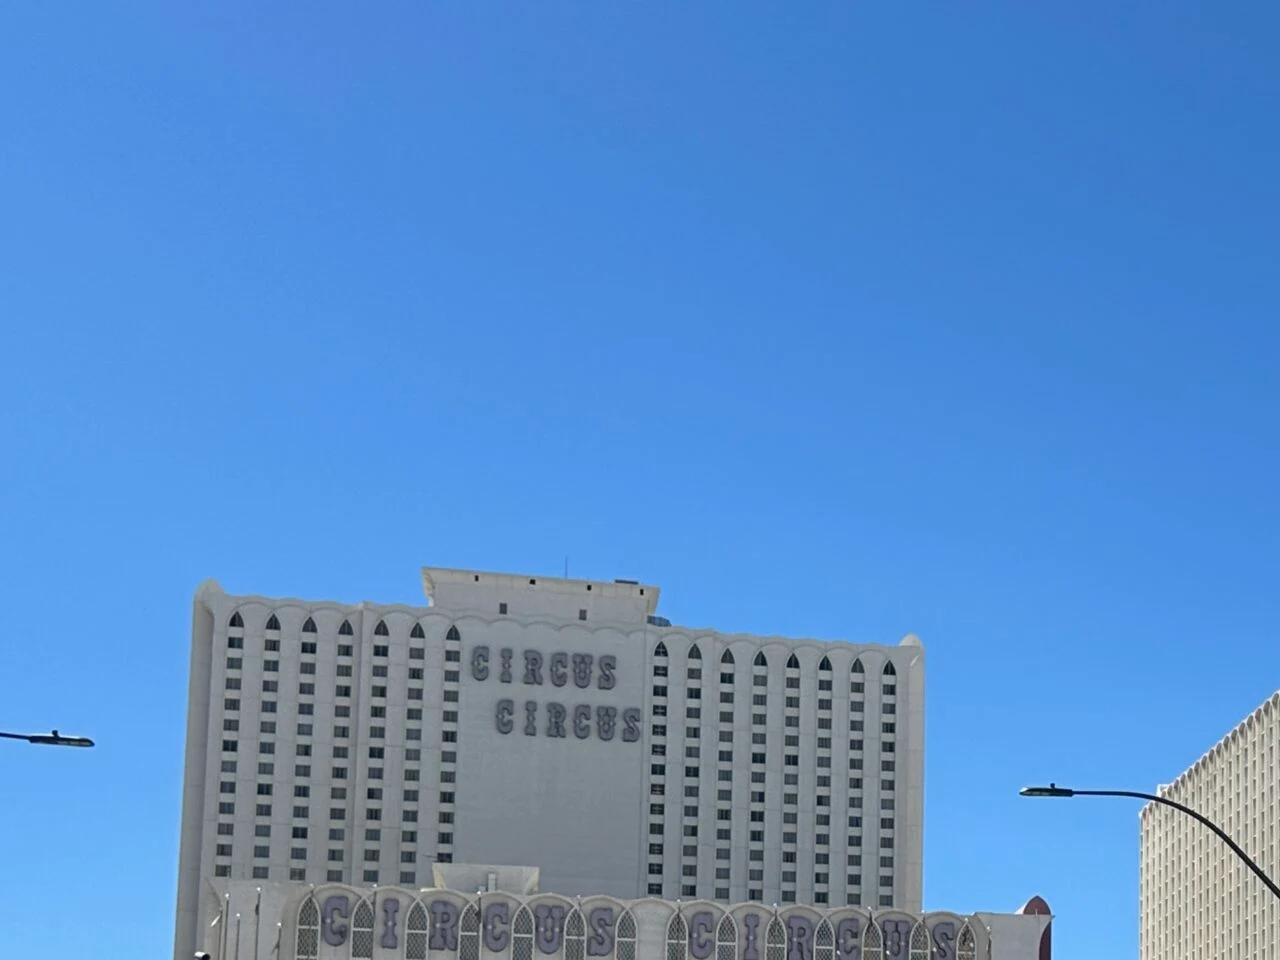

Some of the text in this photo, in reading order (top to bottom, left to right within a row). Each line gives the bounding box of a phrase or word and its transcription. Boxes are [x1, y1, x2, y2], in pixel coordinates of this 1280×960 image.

[471, 646, 617, 690] CIRCUS
[496, 698, 641, 743] CIRCUS
[322, 895, 616, 957] CIRCUS
